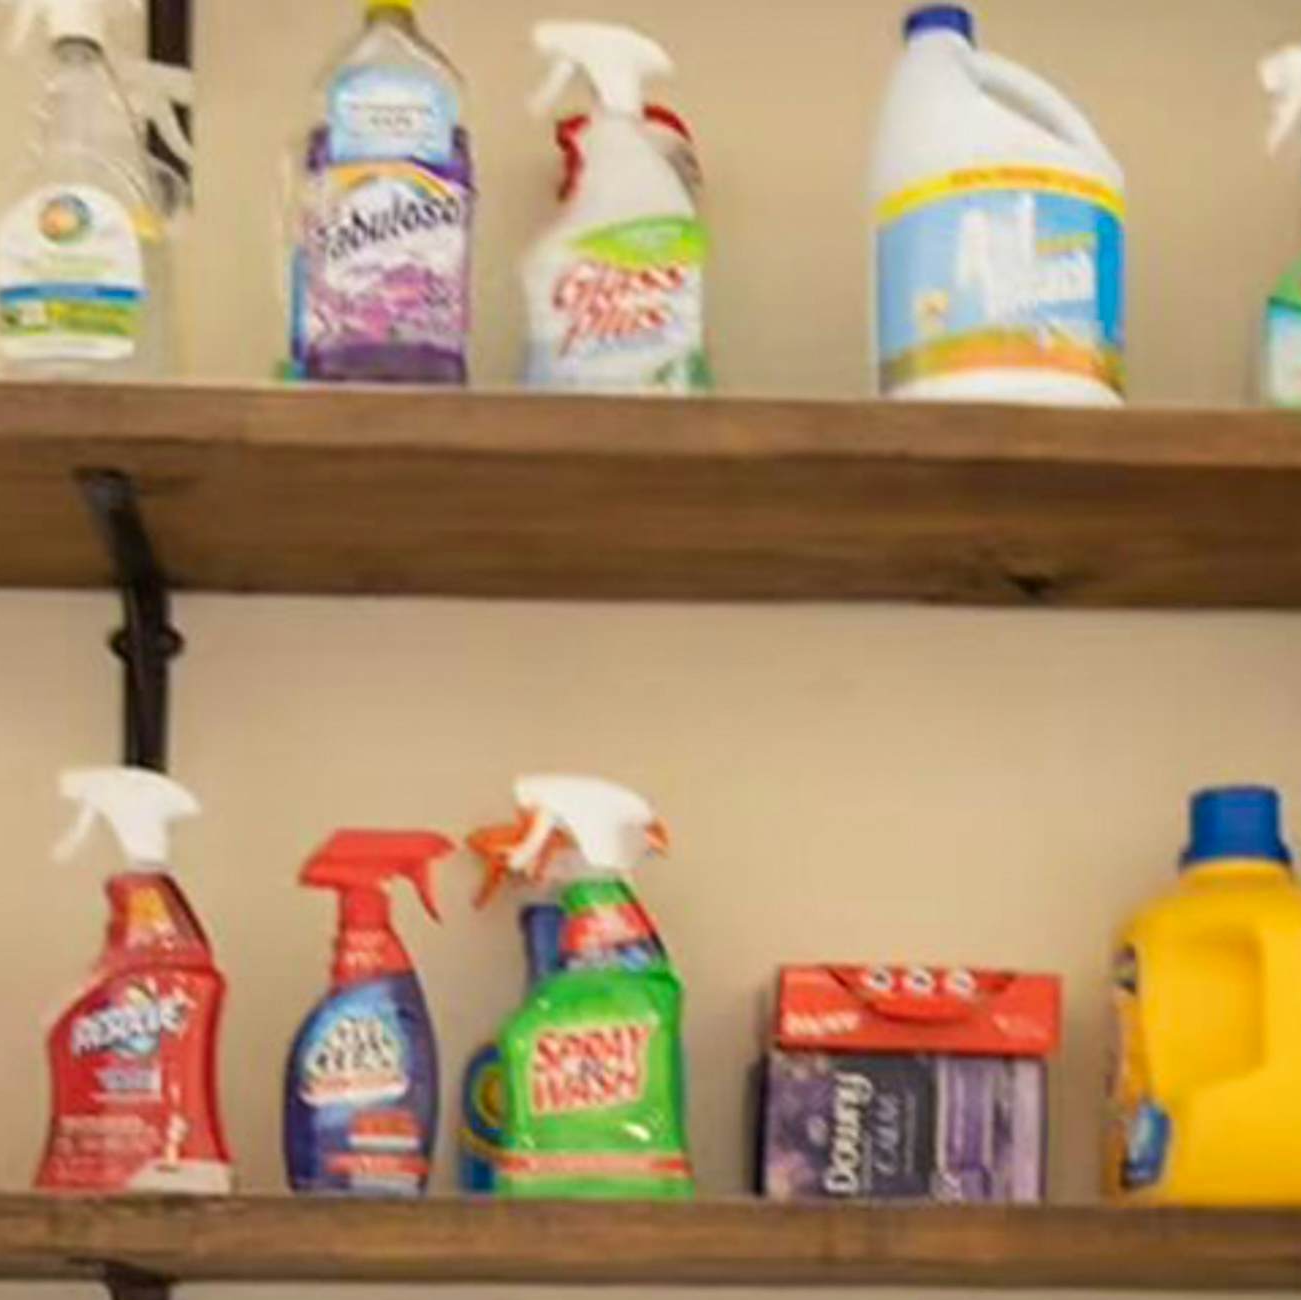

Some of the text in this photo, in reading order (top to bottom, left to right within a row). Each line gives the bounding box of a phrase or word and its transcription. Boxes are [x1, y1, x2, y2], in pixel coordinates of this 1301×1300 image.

[536, 1024, 650, 1064] SPRAY
[532, 1070, 646, 1114] WASH
[823, 1072, 874, 1193] Downy
